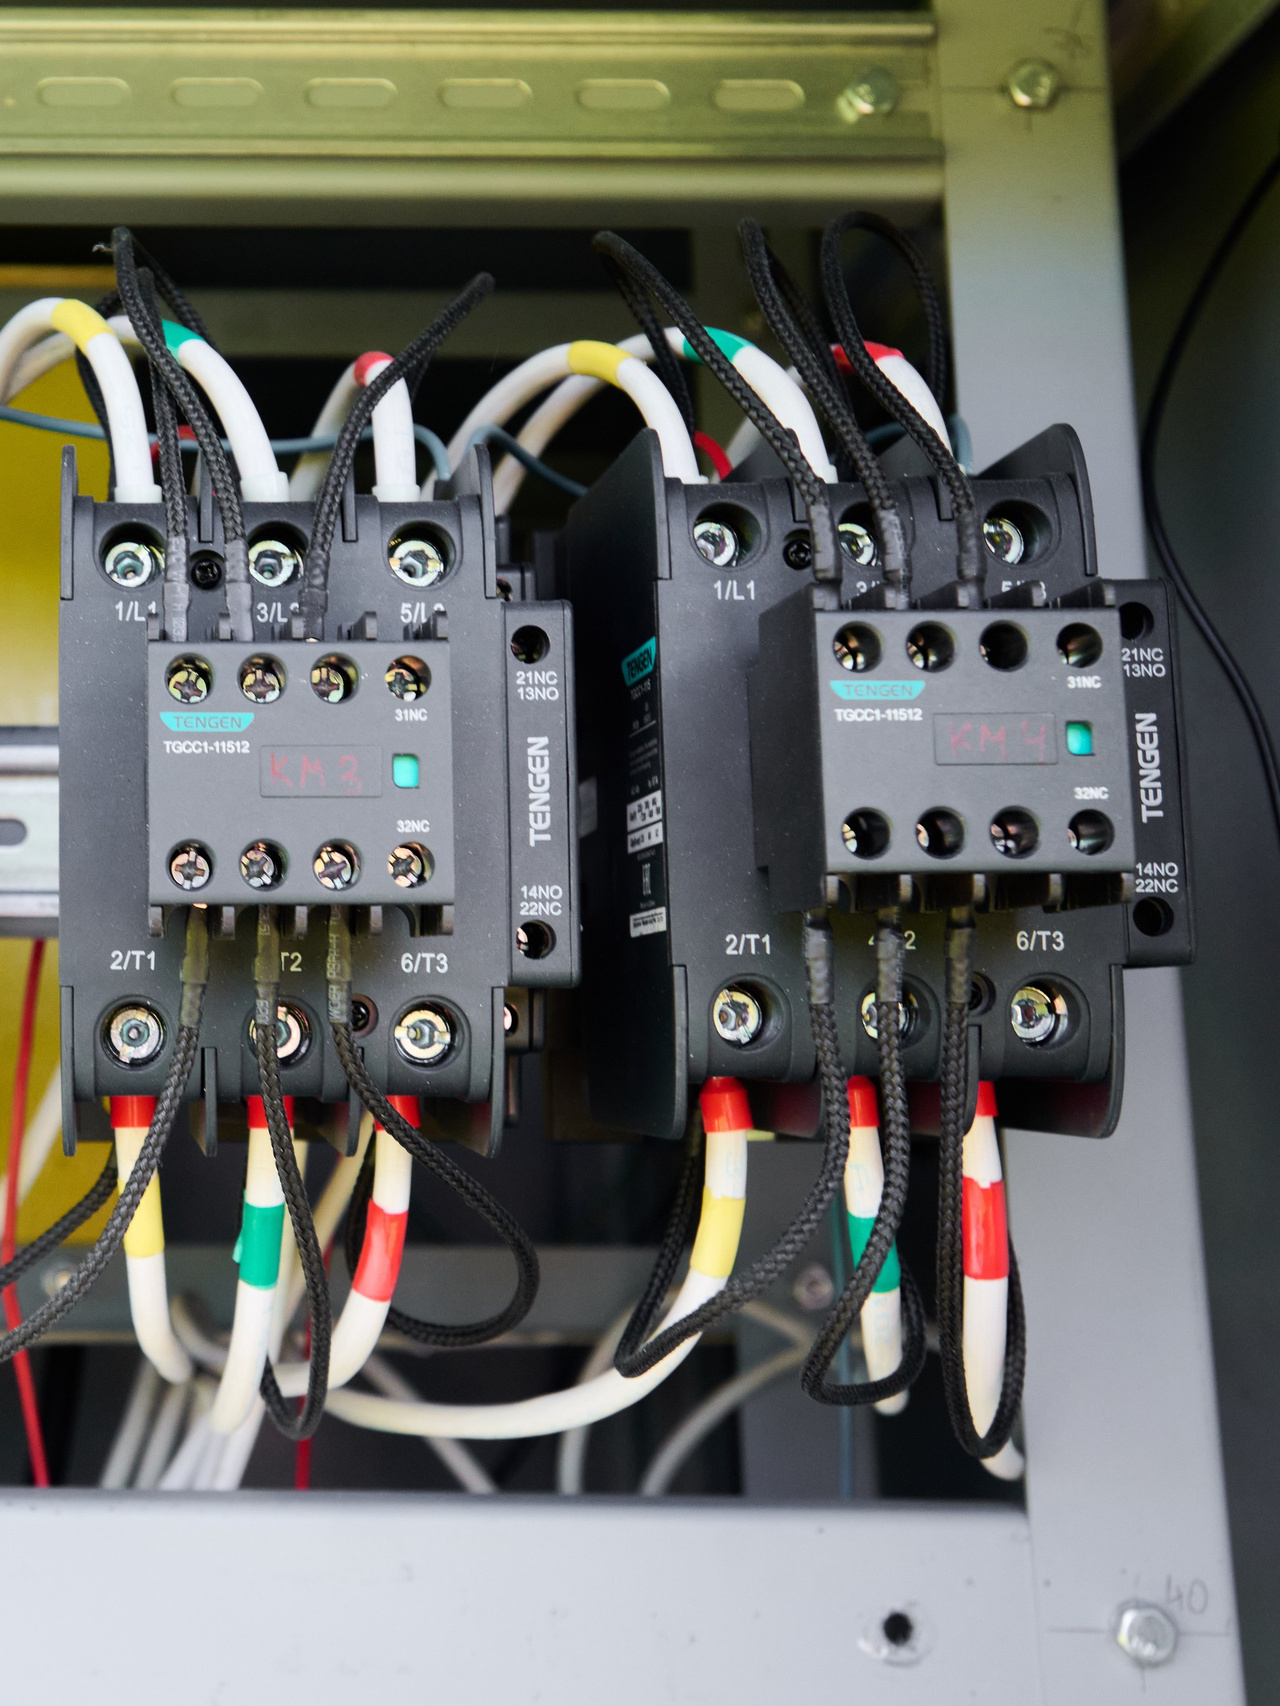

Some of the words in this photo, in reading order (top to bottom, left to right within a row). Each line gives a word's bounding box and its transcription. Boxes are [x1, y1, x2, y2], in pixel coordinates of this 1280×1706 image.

[713, 579, 755, 601] 1/L1
[1121, 647, 1164, 662] 21NC
[516, 670, 558, 685] 21NC
[1123, 663, 1166, 677] 13NO
[1067, 675, 1101, 689] 31NC
[517, 686, 560, 701] 13NO
[844, 682, 913, 698] TENGEN
[172, 715, 243, 730] TENGEN
[395, 708, 428, 722] 31NC
[834, 708, 923, 722] TGCC1-11512
[163, 740, 250, 754] TGCC1-11512
[1134, 712, 1164, 824] TENGEN
[527, 736, 551, 847] TENGEN
[1074, 786, 1109, 800] 32NC
[397, 819, 430, 833] 32NC
[1135, 862, 1179, 877] 14NO
[520, 885, 563, 900] 14NO
[1135, 878, 1179, 893] 22NC
[519, 901, 562, 916] 22NC
[725, 933, 771, 955] 2/T1
[1016, 930, 1065, 952] 6/T3
[109, 950, 156, 971] 2/T1
[400, 952, 449, 974] 6/T3
